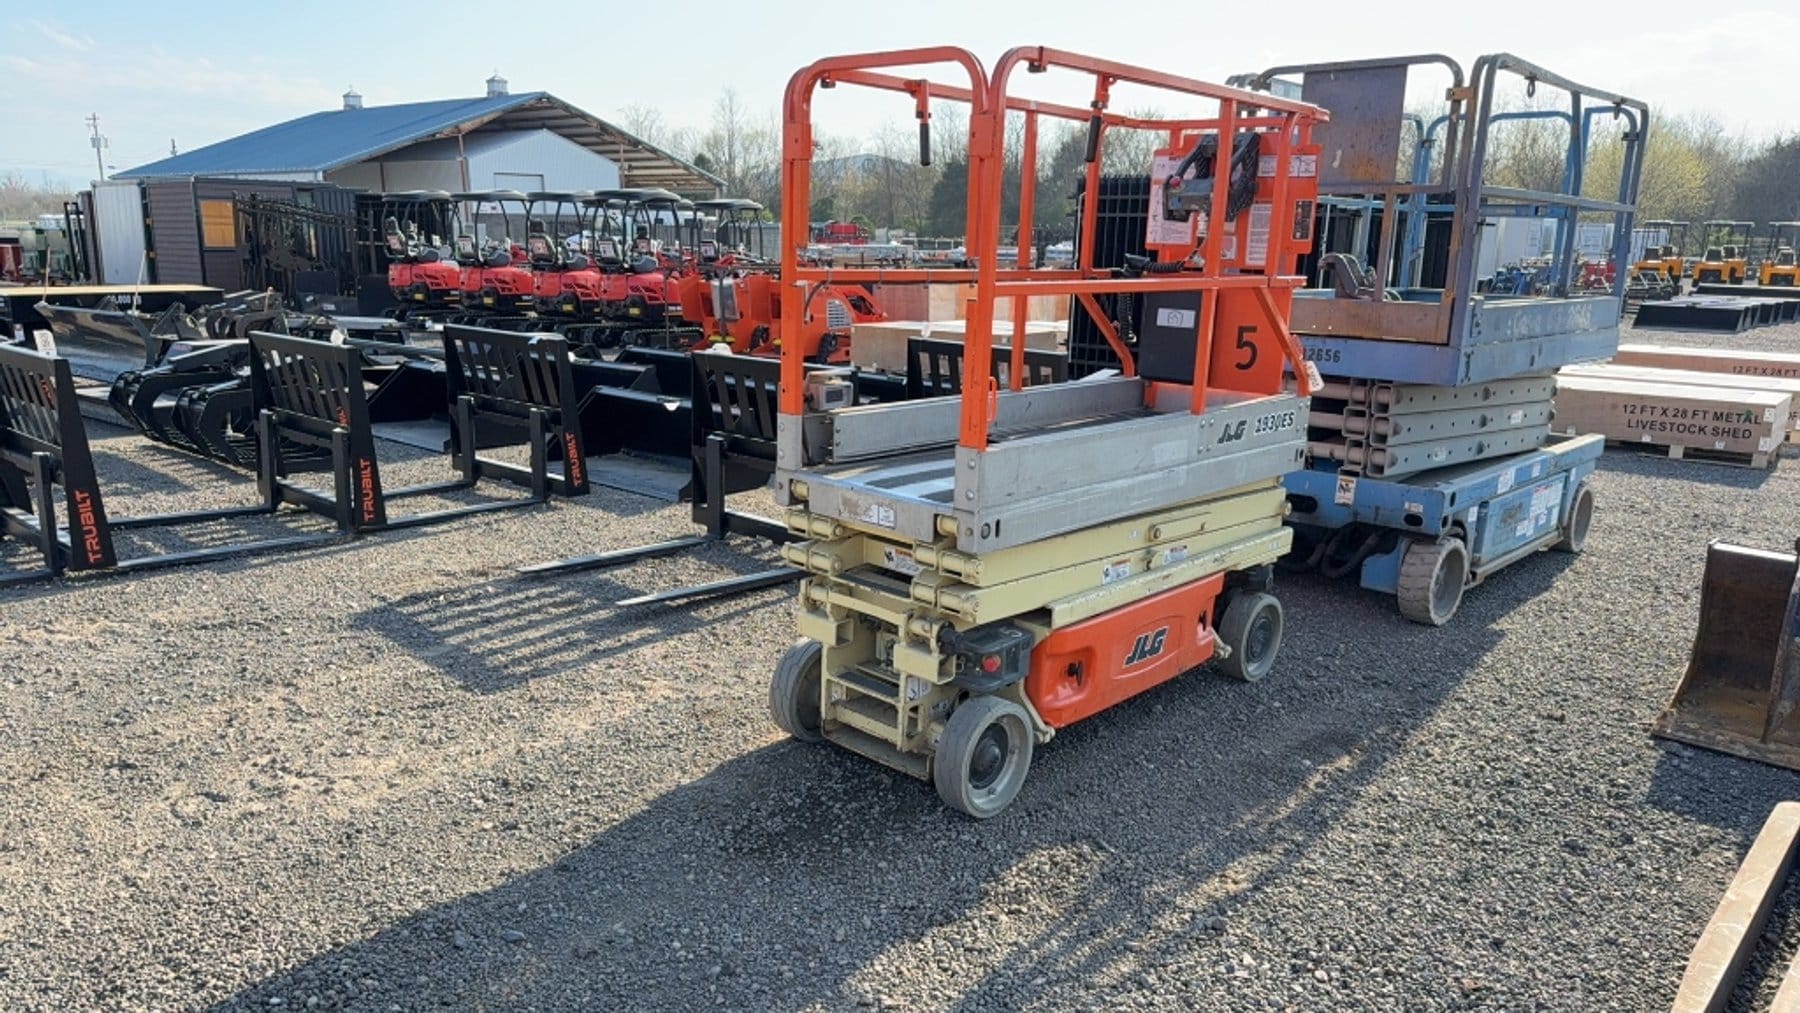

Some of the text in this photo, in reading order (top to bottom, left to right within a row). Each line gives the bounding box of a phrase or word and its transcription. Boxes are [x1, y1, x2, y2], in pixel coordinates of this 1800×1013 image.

[1235, 326, 1258, 370] 5
[1746, 366, 1758, 375] FT
[1761, 367, 1768, 376] X
[1784, 369, 1799, 377] FT
[1217, 419, 1248, 444] JLG
[1622, 404, 1637, 415] 12
[1640, 404, 1658, 416] FT
[1660, 407, 1670, 418] X
[1672, 407, 1688, 419] 28
[1691, 409, 1710, 421] FT
[1712, 410, 1763, 425] METAL
[1627, 418, 1753, 439] LIVESTOCK SHED
[565, 432, 583, 487] TRUBILT
[360, 458, 376, 522] TRUBILT
[74, 489, 103, 565] TRUBILT
[1124, 626, 1169, 667] JLG
